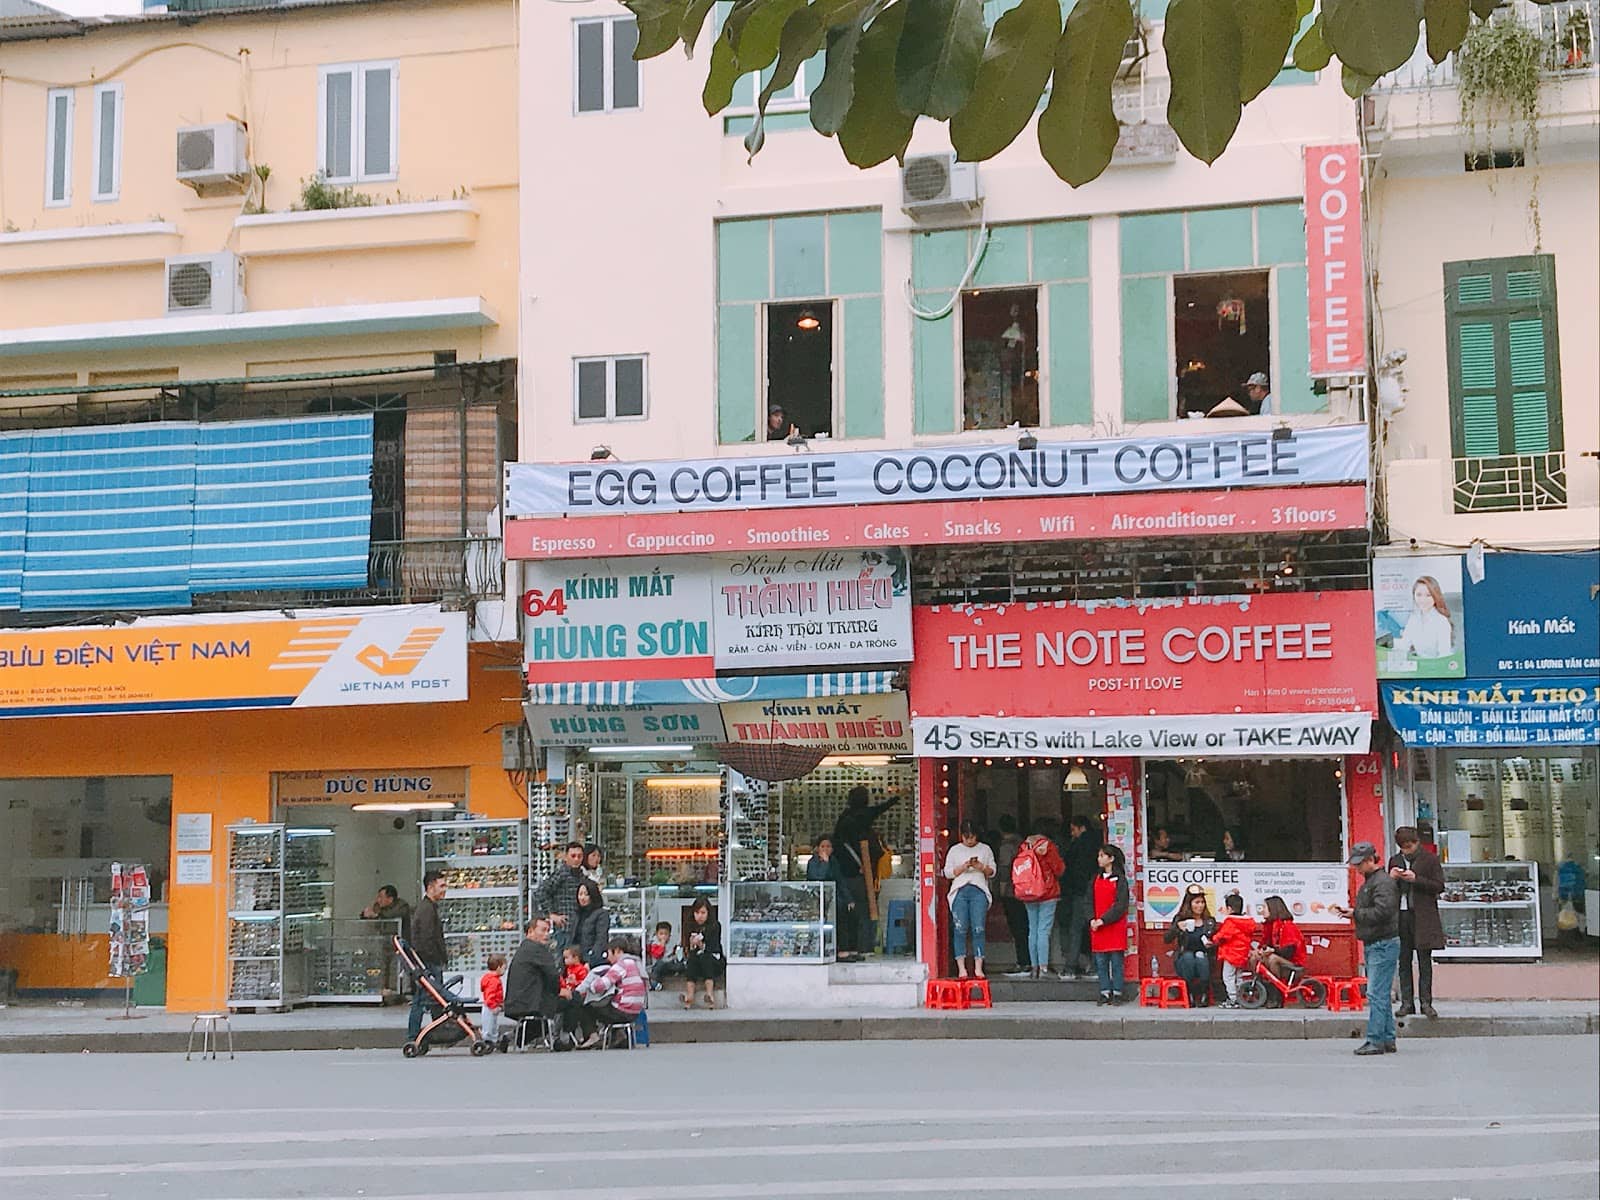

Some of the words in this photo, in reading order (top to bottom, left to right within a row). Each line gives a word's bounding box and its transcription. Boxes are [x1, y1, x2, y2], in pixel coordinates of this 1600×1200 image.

[1319, 153, 1350, 364] COFFEE
[568, 467, 657, 506] EGG
[670, 461, 838, 504] COFFEE
[873, 448, 1099, 495] COCONUT
[1114, 436, 1299, 484] COFFEE
[532, 534, 596, 553] Espresso
[626, 531, 716, 552] Cappuccino
[747, 526, 831, 544] Smoothies
[864, 524, 910, 541] Cakes
[945, 518, 1002, 536] Snacks
[1039, 515, 1075, 534] Wifi
[1111, 510, 1237, 531] Airconditioner
[566, 571, 618, 600] KÍNH
[629, 567, 675, 597] MẮT
[523, 589, 567, 616] 64
[721, 577, 818, 619] THÀNH
[827, 618, 879, 635] TRANG
[1508, 619, 1541, 635] Kính
[1544, 615, 1576, 634] Mắt
[534, 618, 628, 661] HÙNG
[637, 618, 708, 657] SƠN
[947, 632, 1022, 669] THE
[1036, 629, 1146, 668] NOTE
[1162, 622, 1333, 664] COFFEE
[54, 642, 114, 668] ĐIỆN
[124, 638, 182, 666] VIỆT
[191, 639, 251, 660] NAM
[340, 680, 405, 692] VIETNAM
[411, 678, 451, 689] POST
[1088, 677, 1141, 692] POST-IT
[1145, 675, 1183, 691] LOVE
[1392, 687, 1460, 705] KÍNH
[1467, 682, 1526, 704] MẮT
[1531, 688, 1588, 707] THỌ
[762, 703, 811, 716] KÍNH
[816, 699, 863, 716] MẮT
[1420, 707, 1442, 724] BÁN
[1444, 708, 1473, 724] BUÔN
[1482, 707, 1504, 724] BÁN
[1520, 705, 1546, 724] KÍNH
[1548, 704, 1572, 723] MẮT
[550, 714, 626, 734] HÙNG
[642, 713, 700, 731] SƠN
[732, 720, 830, 741] THÀNH
[878, 741, 908, 752] TRANG
[923, 724, 963, 753] 45
[969, 730, 1039, 749] SEATS
[1044, 726, 1087, 748] with
[1091, 727, 1143, 749] Lake
[1148, 727, 1198, 749] View
[1204, 731, 1227, 748] or
[1232, 727, 1295, 747] TAKE
[1297, 725, 1361, 747] AWAY
[1356, 759, 1379, 775] 64
[1148, 869, 1179, 884] EGG
[1183, 869, 1239, 884] COFFEE
